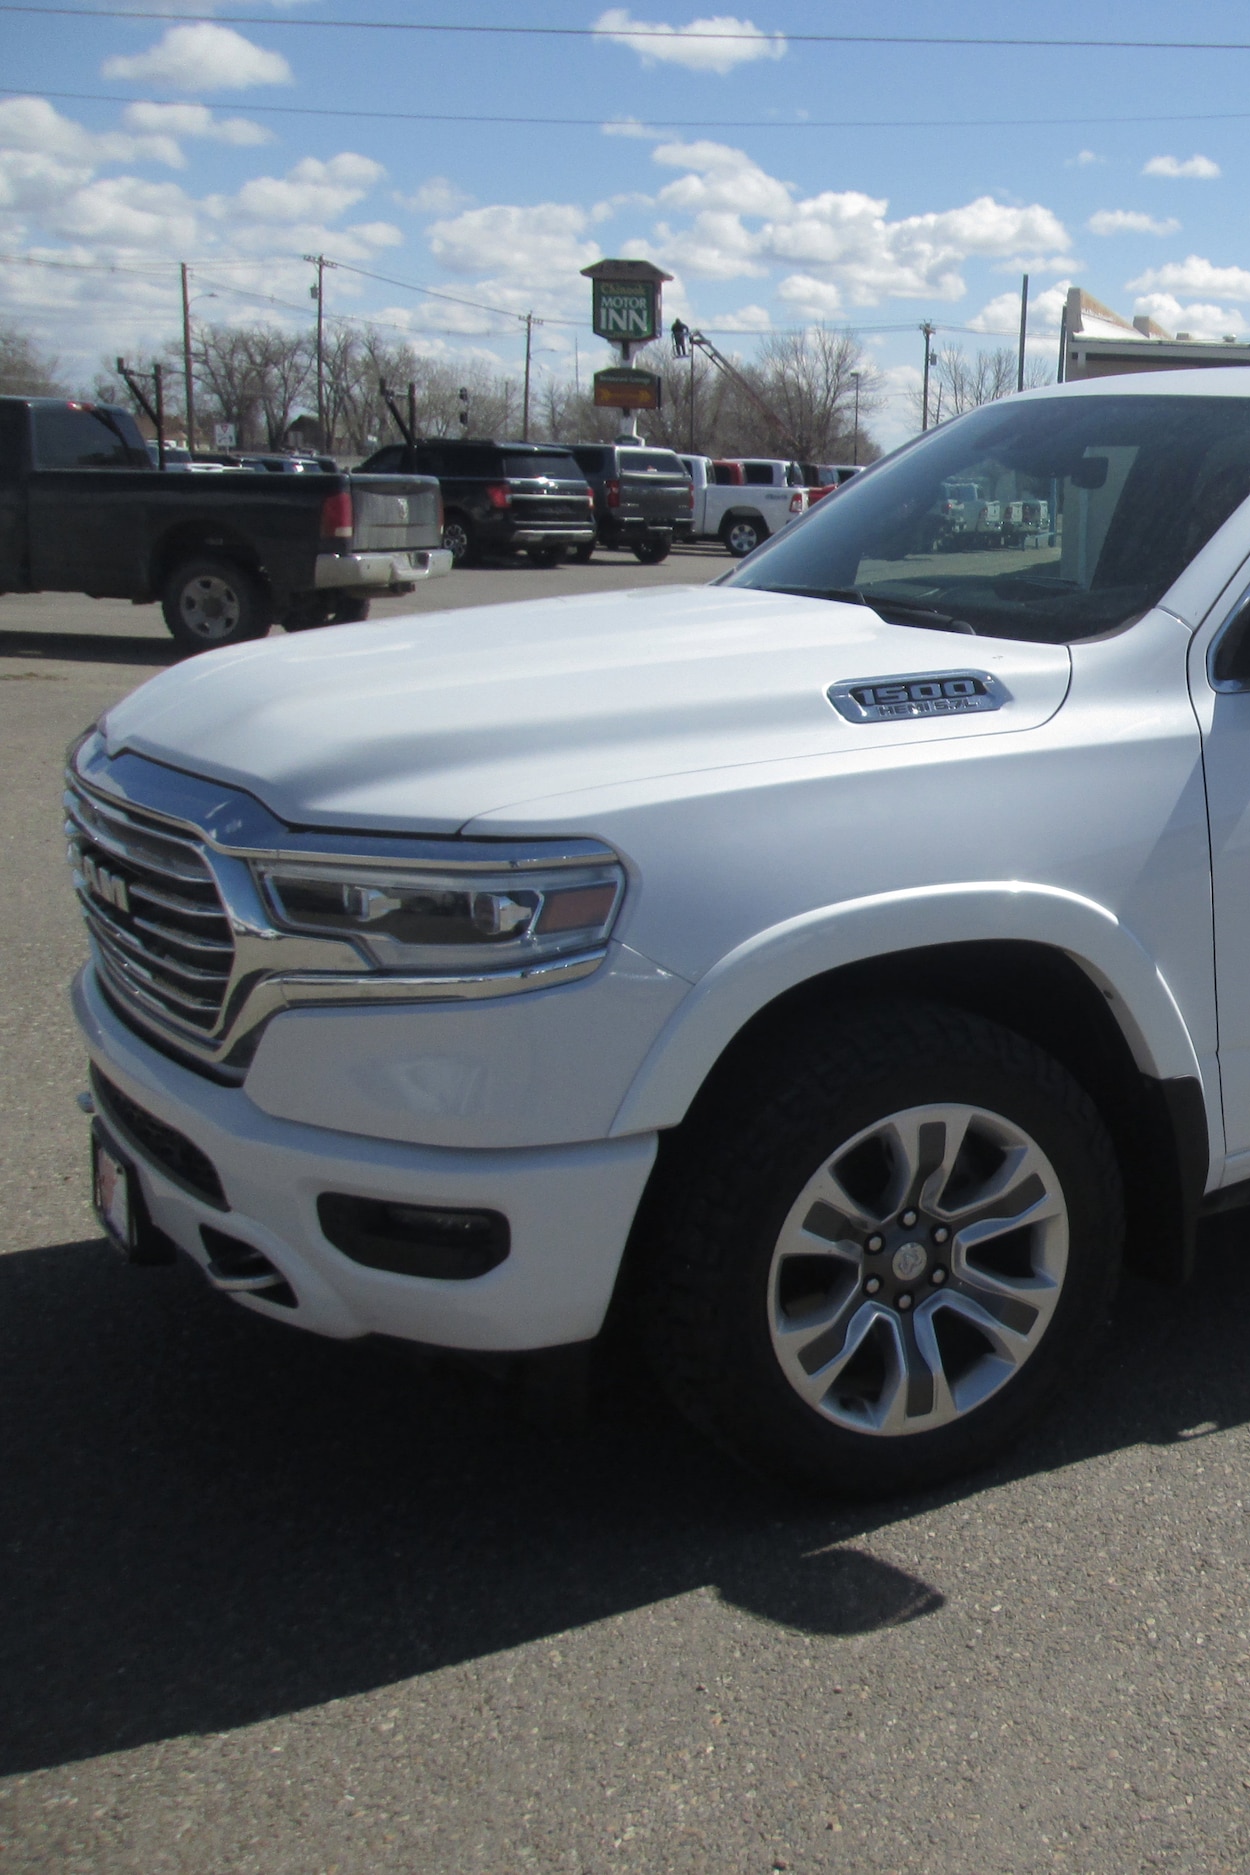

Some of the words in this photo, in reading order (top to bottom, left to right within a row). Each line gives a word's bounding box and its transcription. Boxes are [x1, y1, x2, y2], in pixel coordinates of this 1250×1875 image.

[601, 295, 646, 309] MOTOR
[600, 307, 647, 331] INN
[858, 679, 975, 705] 1500
[877, 702, 932, 717] HEMI
